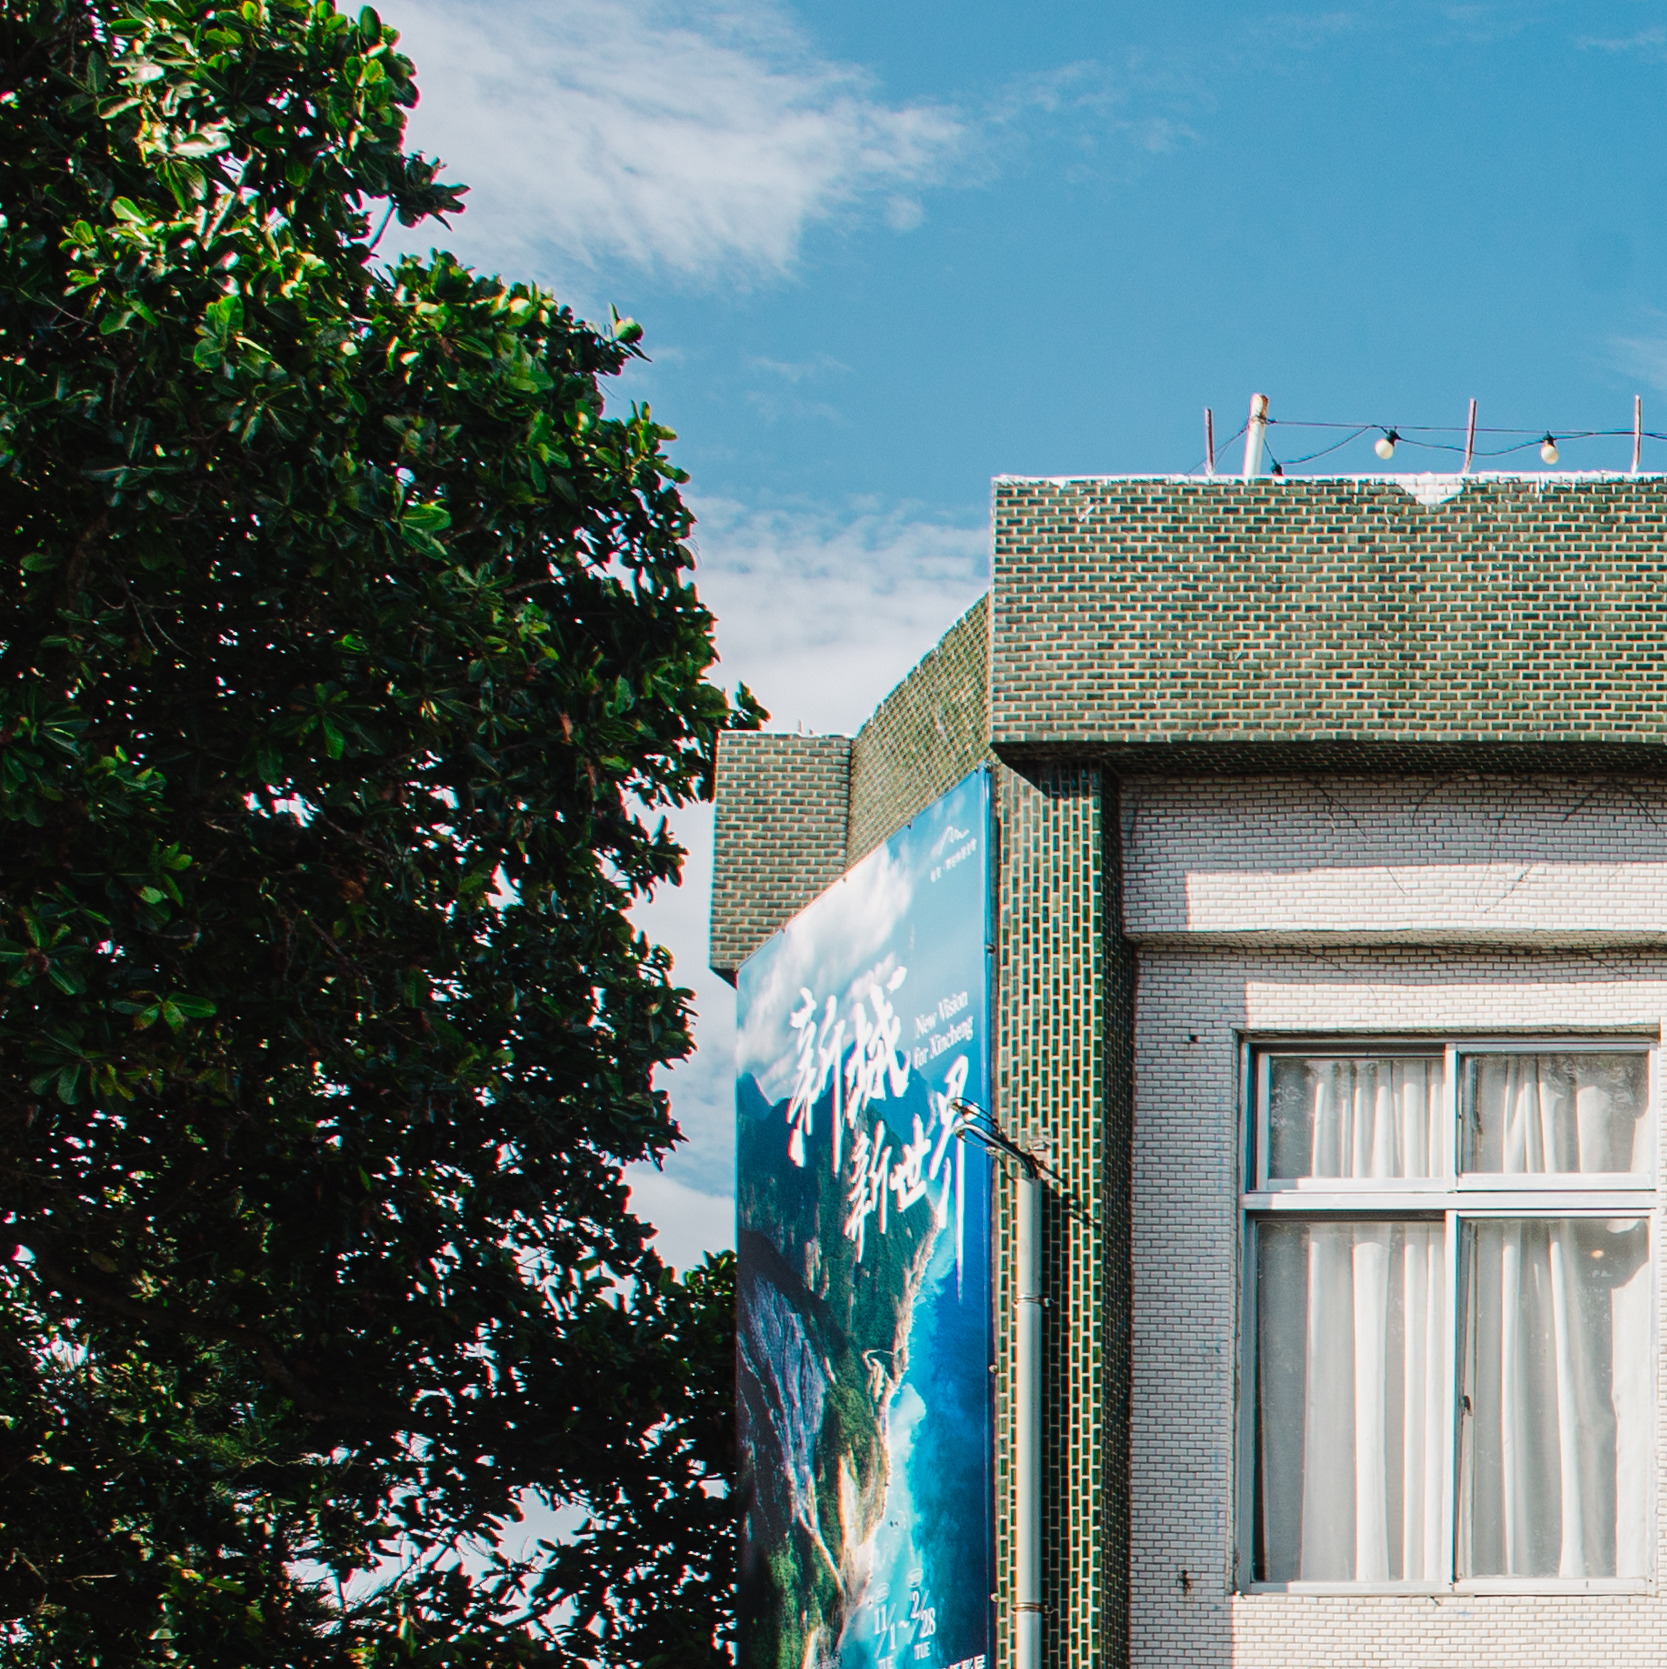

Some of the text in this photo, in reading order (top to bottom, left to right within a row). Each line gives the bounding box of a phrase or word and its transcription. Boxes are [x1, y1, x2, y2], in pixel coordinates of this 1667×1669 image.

[914, 991, 968, 1039] New Vision
[912, 1015, 973, 1069] for Xincheng
[787, 966, 911, 1181] 新城
[914, 1641, 930, 1660] TUE
